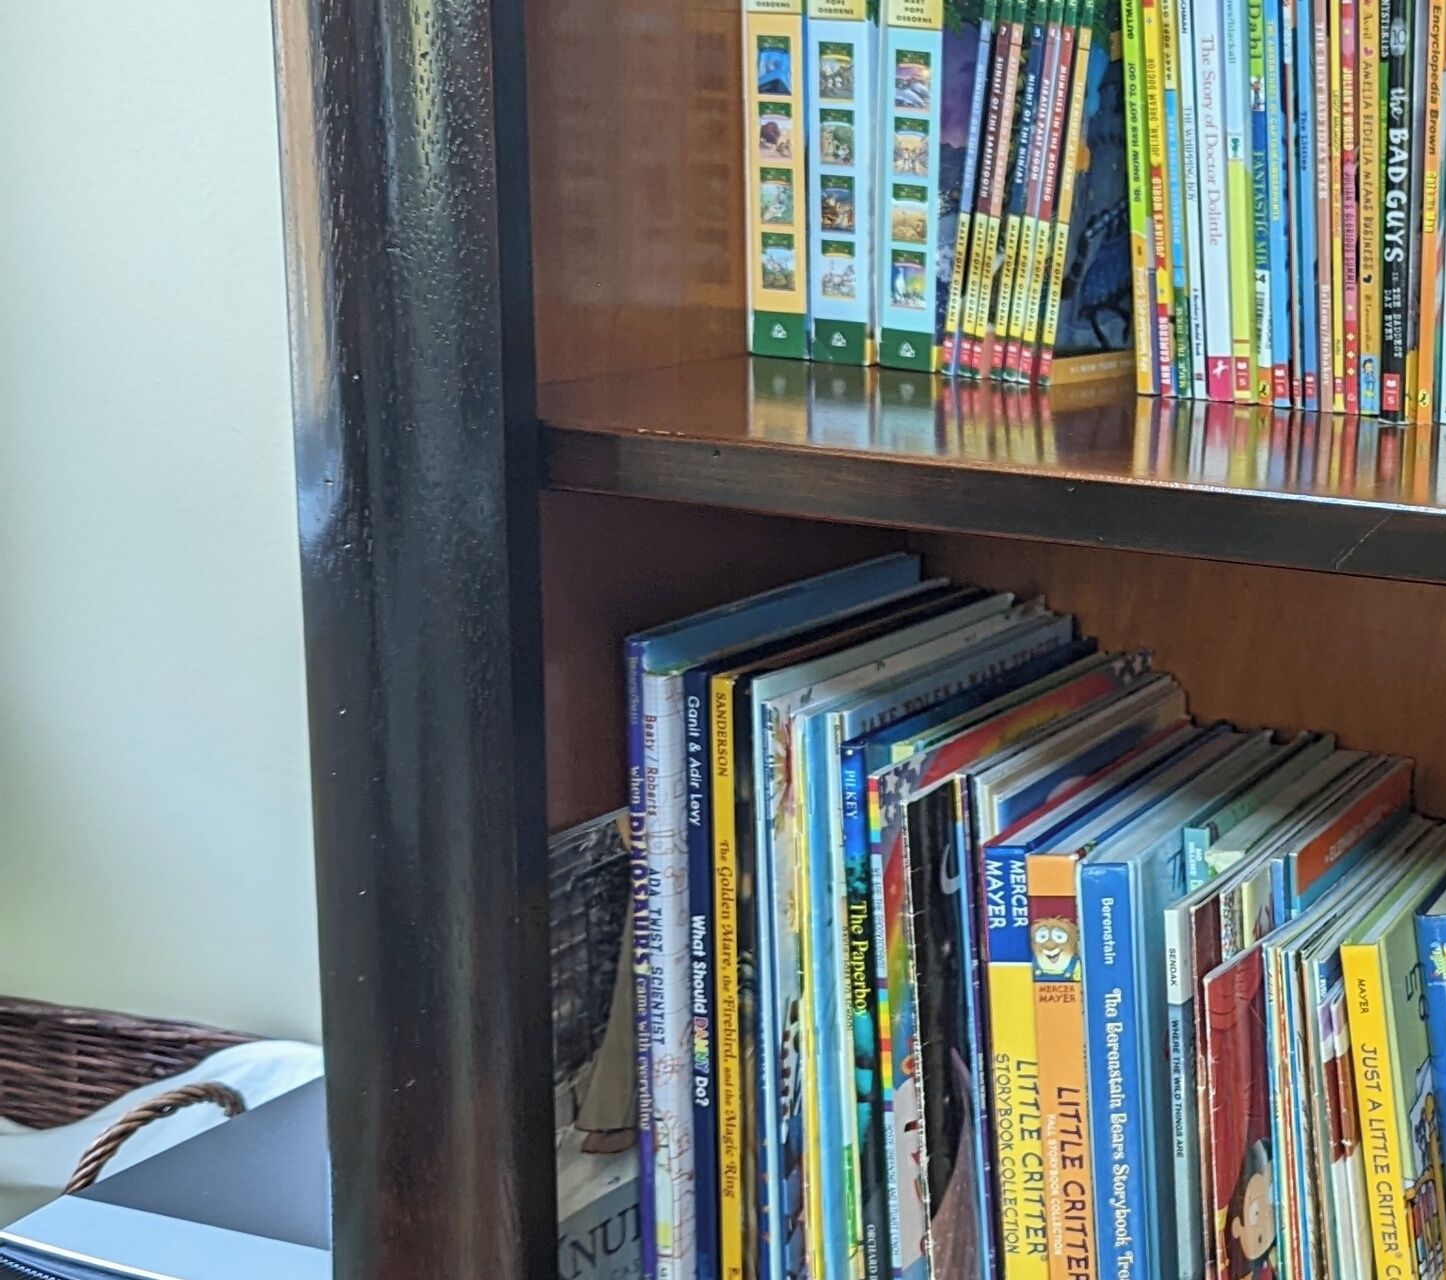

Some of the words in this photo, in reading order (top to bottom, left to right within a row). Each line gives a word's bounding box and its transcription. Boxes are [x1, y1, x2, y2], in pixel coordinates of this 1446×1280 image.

[1200, 35, 1214, 65] The
[1248, 2, 1262, 60] Dahl
[1428, 4, 1443, 104] Encyclopedia
[1201, 70, 1216, 108] Story
[1390, 87, 1408, 121] the
[1205, 114, 1218, 130] of
[1429, 109, 1440, 155] Brown
[1206, 133, 1219, 184] Doctor
[1388, 128, 1409, 183] BAD
[1207, 189, 1222, 245] Dolittle
[1383, 190, 1408, 263] GUYS
[644, 715, 658, 751] Beaty
[687, 696, 701, 737] Ganit
[715, 691, 729, 777] SANDERSON
[688, 742, 700, 753] &
[689, 757, 702, 788] Adir
[647, 767, 659, 817] Roberts
[688, 794, 703, 826] Levy
[844, 768, 858, 820] PILKEY
[718, 840, 731, 861] The
[717, 865, 733, 920] Golden
[851, 900, 867, 935] The
[986, 859, 1008, 929] MAYER
[1011, 859, 1029, 928] MERCER
[691, 914, 707, 956] What
[719, 923, 734, 969] Mare,
[1101, 896, 1117, 965] Berenstain
[693, 961, 709, 1014] Should
[851, 939, 872, 1019] Paperboy
[1039, 984, 1076, 993] MERCER
[1169, 947, 1178, 986] SENDAK
[651, 966, 665, 1045] SCIENTIST
[1039, 995, 1077, 1004] MAYER
[1106, 987, 1123, 1017] The
[1358, 978, 1370, 1014] MAYER
[693, 1016, 710, 1073] DANNY
[723, 994, 736, 1062] Firebird,
[1172, 1020, 1182, 1054] WHERE
[1106, 1021, 1126, 1108] Berenstain
[1361, 1042, 1382, 1093] JUST
[637, 1055, 655, 1131] everything
[694, 1075, 710, 1107] Do?
[996, 1052, 1014, 1150] STORYBOOK
[1016, 1059, 1043, 1141] LITTLE
[723, 1110, 738, 1156] Magic
[1056, 1085, 1085, 1169] LITTLE
[1111, 1113, 1127, 1159] Bears
[1175, 1103, 1184, 1138] THINGS
[1369, 1117, 1389, 1175] LITTLE
[723, 1159, 739, 1199] Ring
[1048, 1138, 1060, 1195] STORYBOOK
[1000, 1155, 1019, 1254] COLLECTION
[1050, 1197, 1062, 1255] COLLECTION
[1109, 1162, 1131, 1247] Storybook
[867, 1224, 878, 1273] ORCHARD
